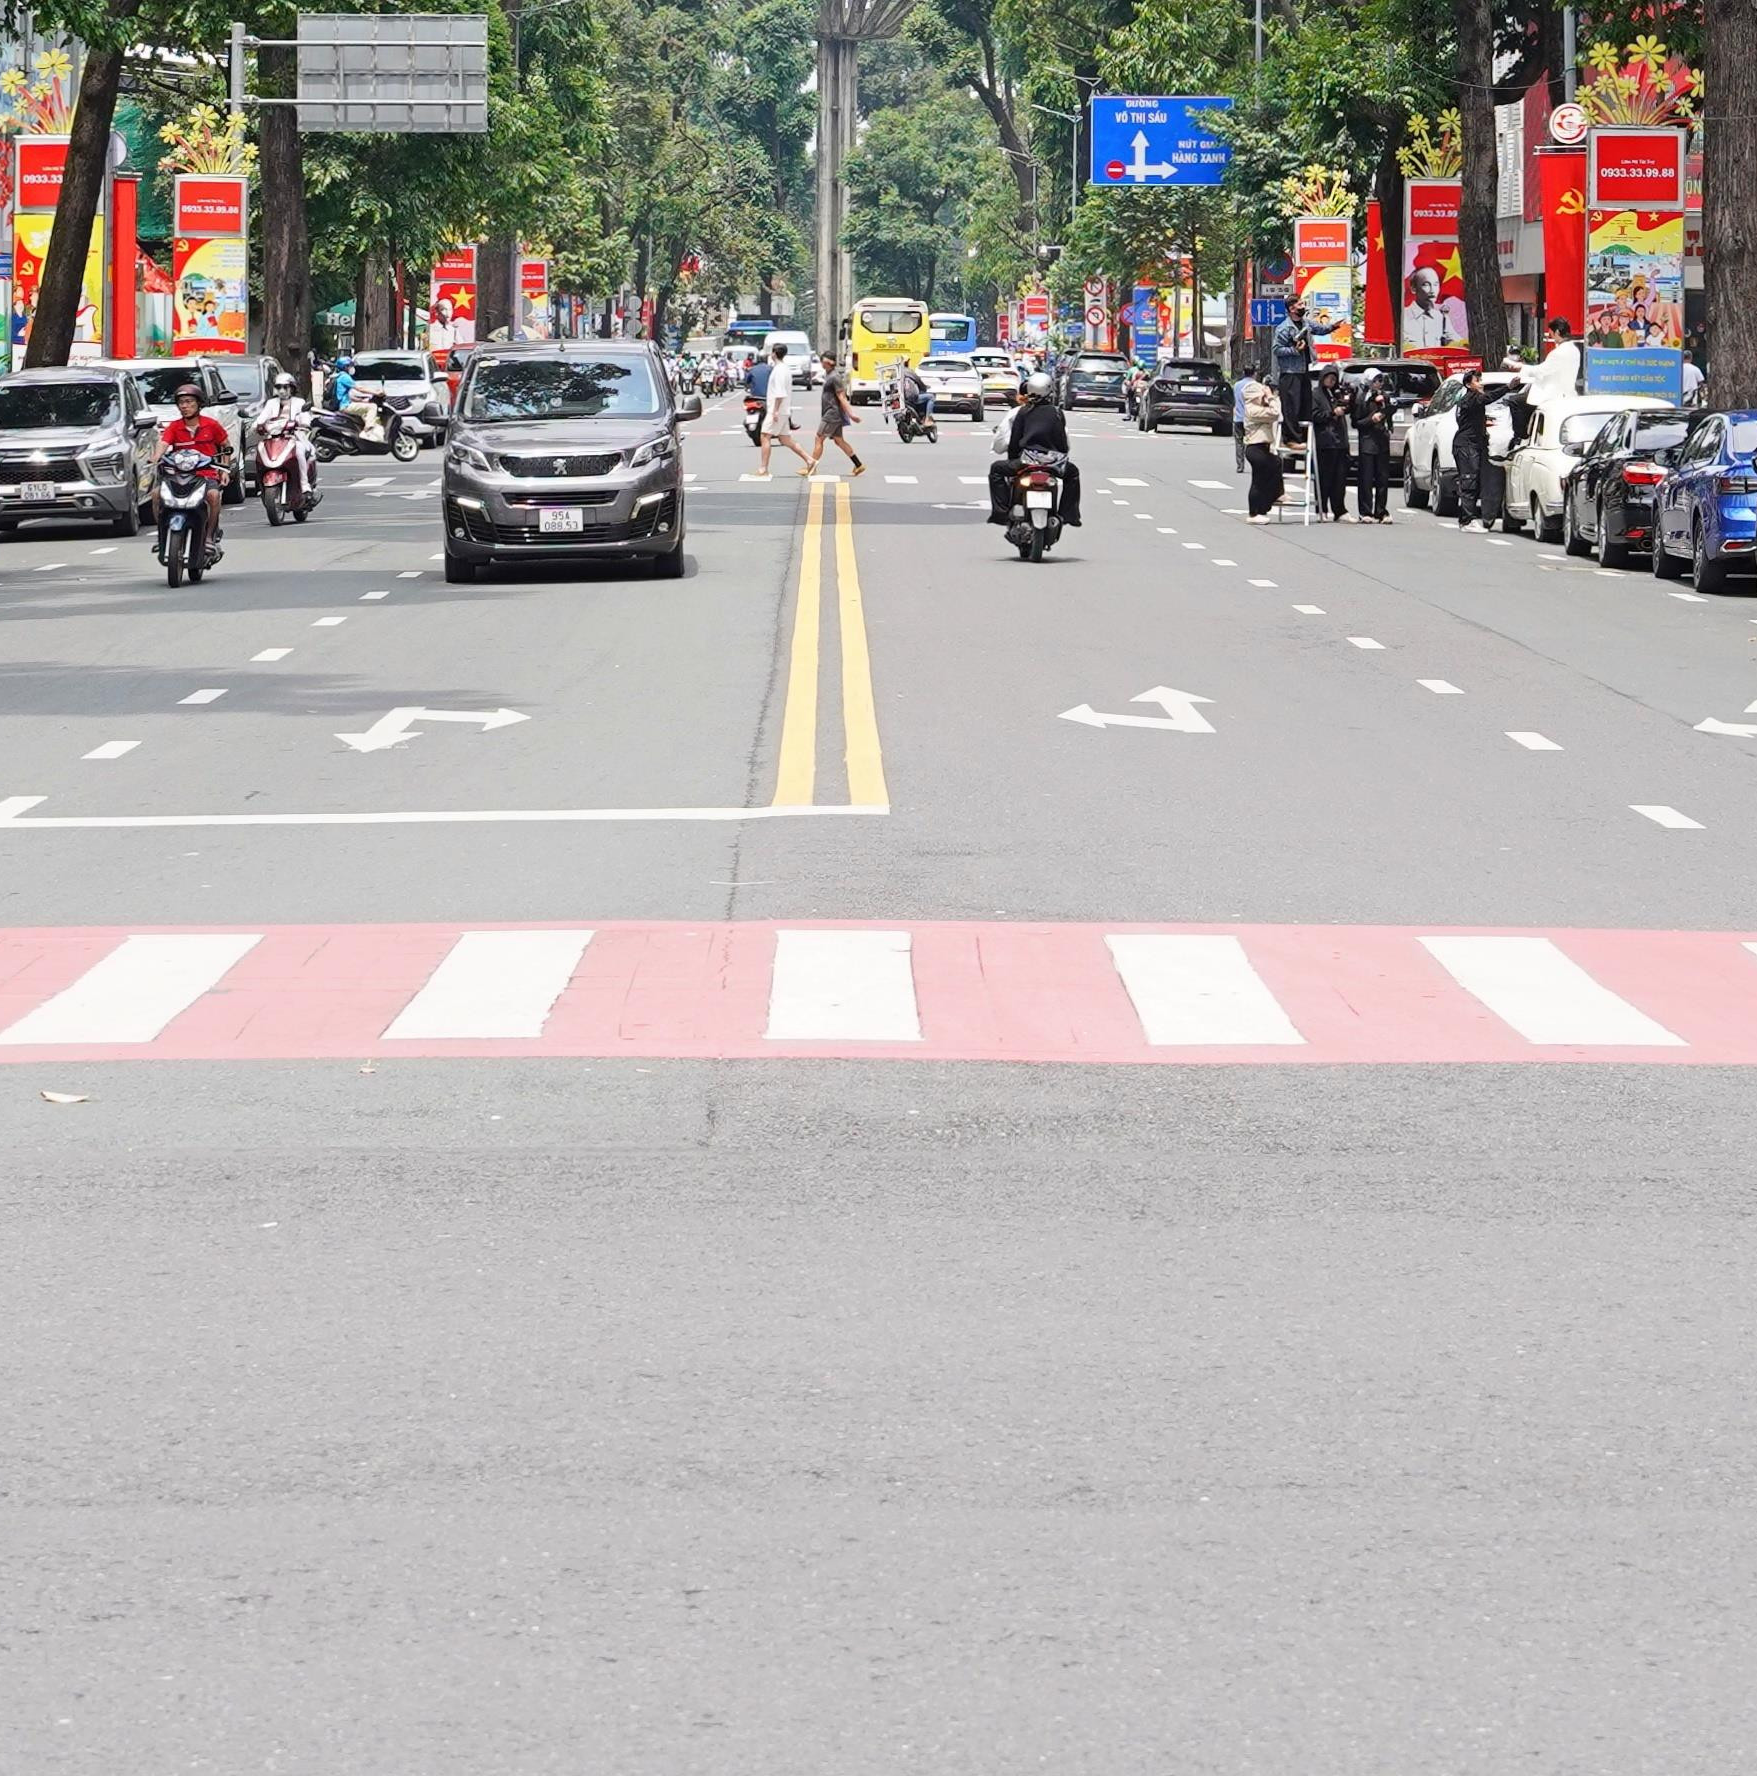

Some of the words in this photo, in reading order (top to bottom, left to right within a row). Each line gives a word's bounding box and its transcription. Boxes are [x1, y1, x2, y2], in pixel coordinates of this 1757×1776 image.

[1130, 112, 1146, 124] THỊ
[1172, 151, 1198, 164] HÀNG
[1200, 153, 1226, 163] XANH
[1601, 167, 1675, 178] 0933.33.99.88
[551, 510, 570, 521] 95A
